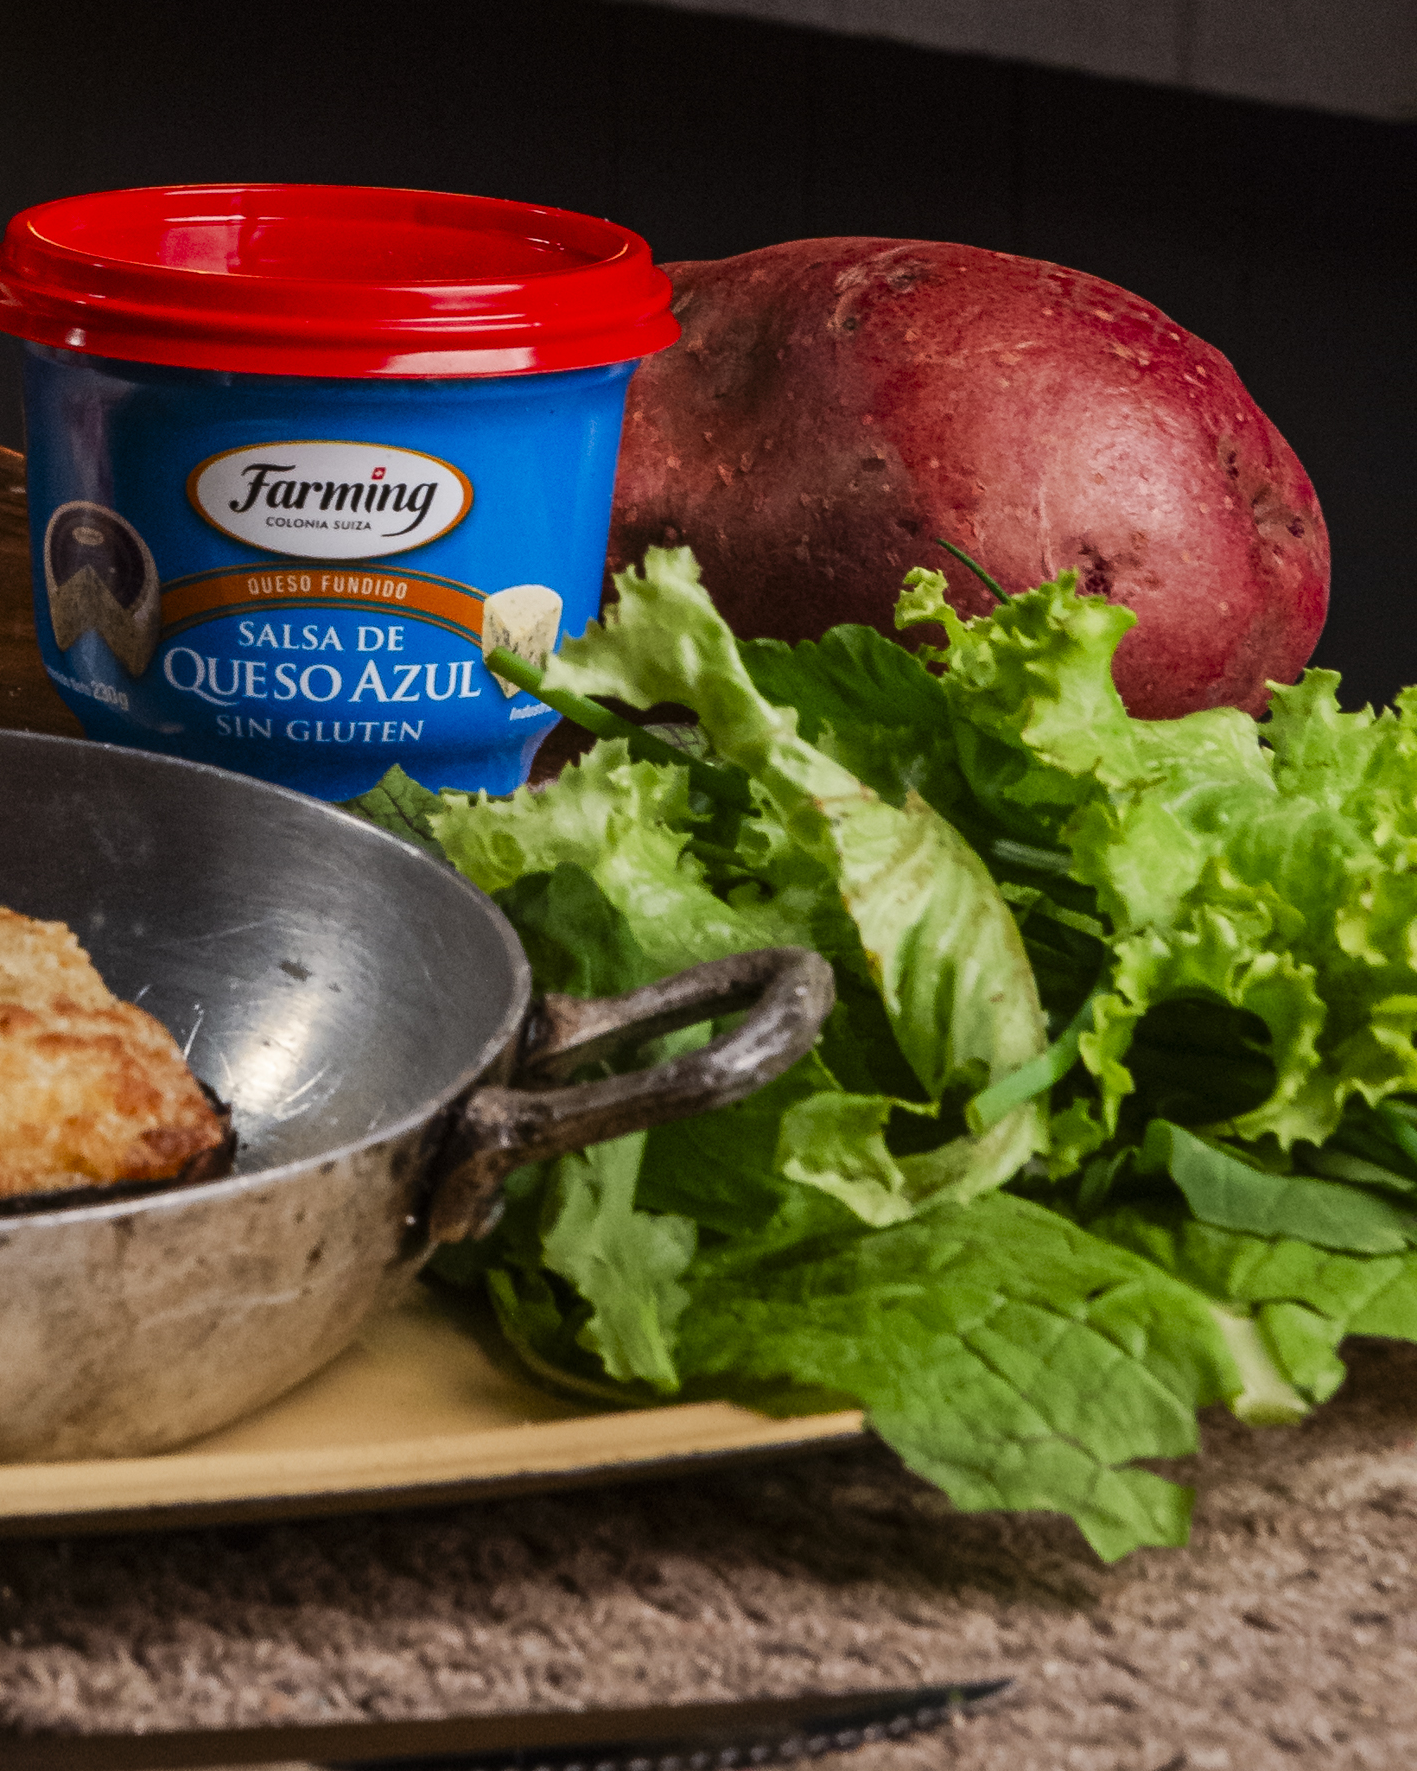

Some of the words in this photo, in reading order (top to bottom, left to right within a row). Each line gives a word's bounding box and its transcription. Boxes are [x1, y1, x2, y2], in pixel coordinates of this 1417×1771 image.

[228, 463, 438, 537] Farming
[265, 516, 328, 529] COLONIA
[333, 520, 372, 530] SUIZA
[247, 575, 311, 595] QUESO
[321, 575, 408, 600] FUNDIDO
[238, 620, 344, 652] SALSA
[357, 626, 405, 651] DE
[163, 646, 343, 707] QUESO
[347, 659, 482, 703] AZUL
[216, 715, 272, 739] SIN
[285, 720, 425, 743] GLUTEN
